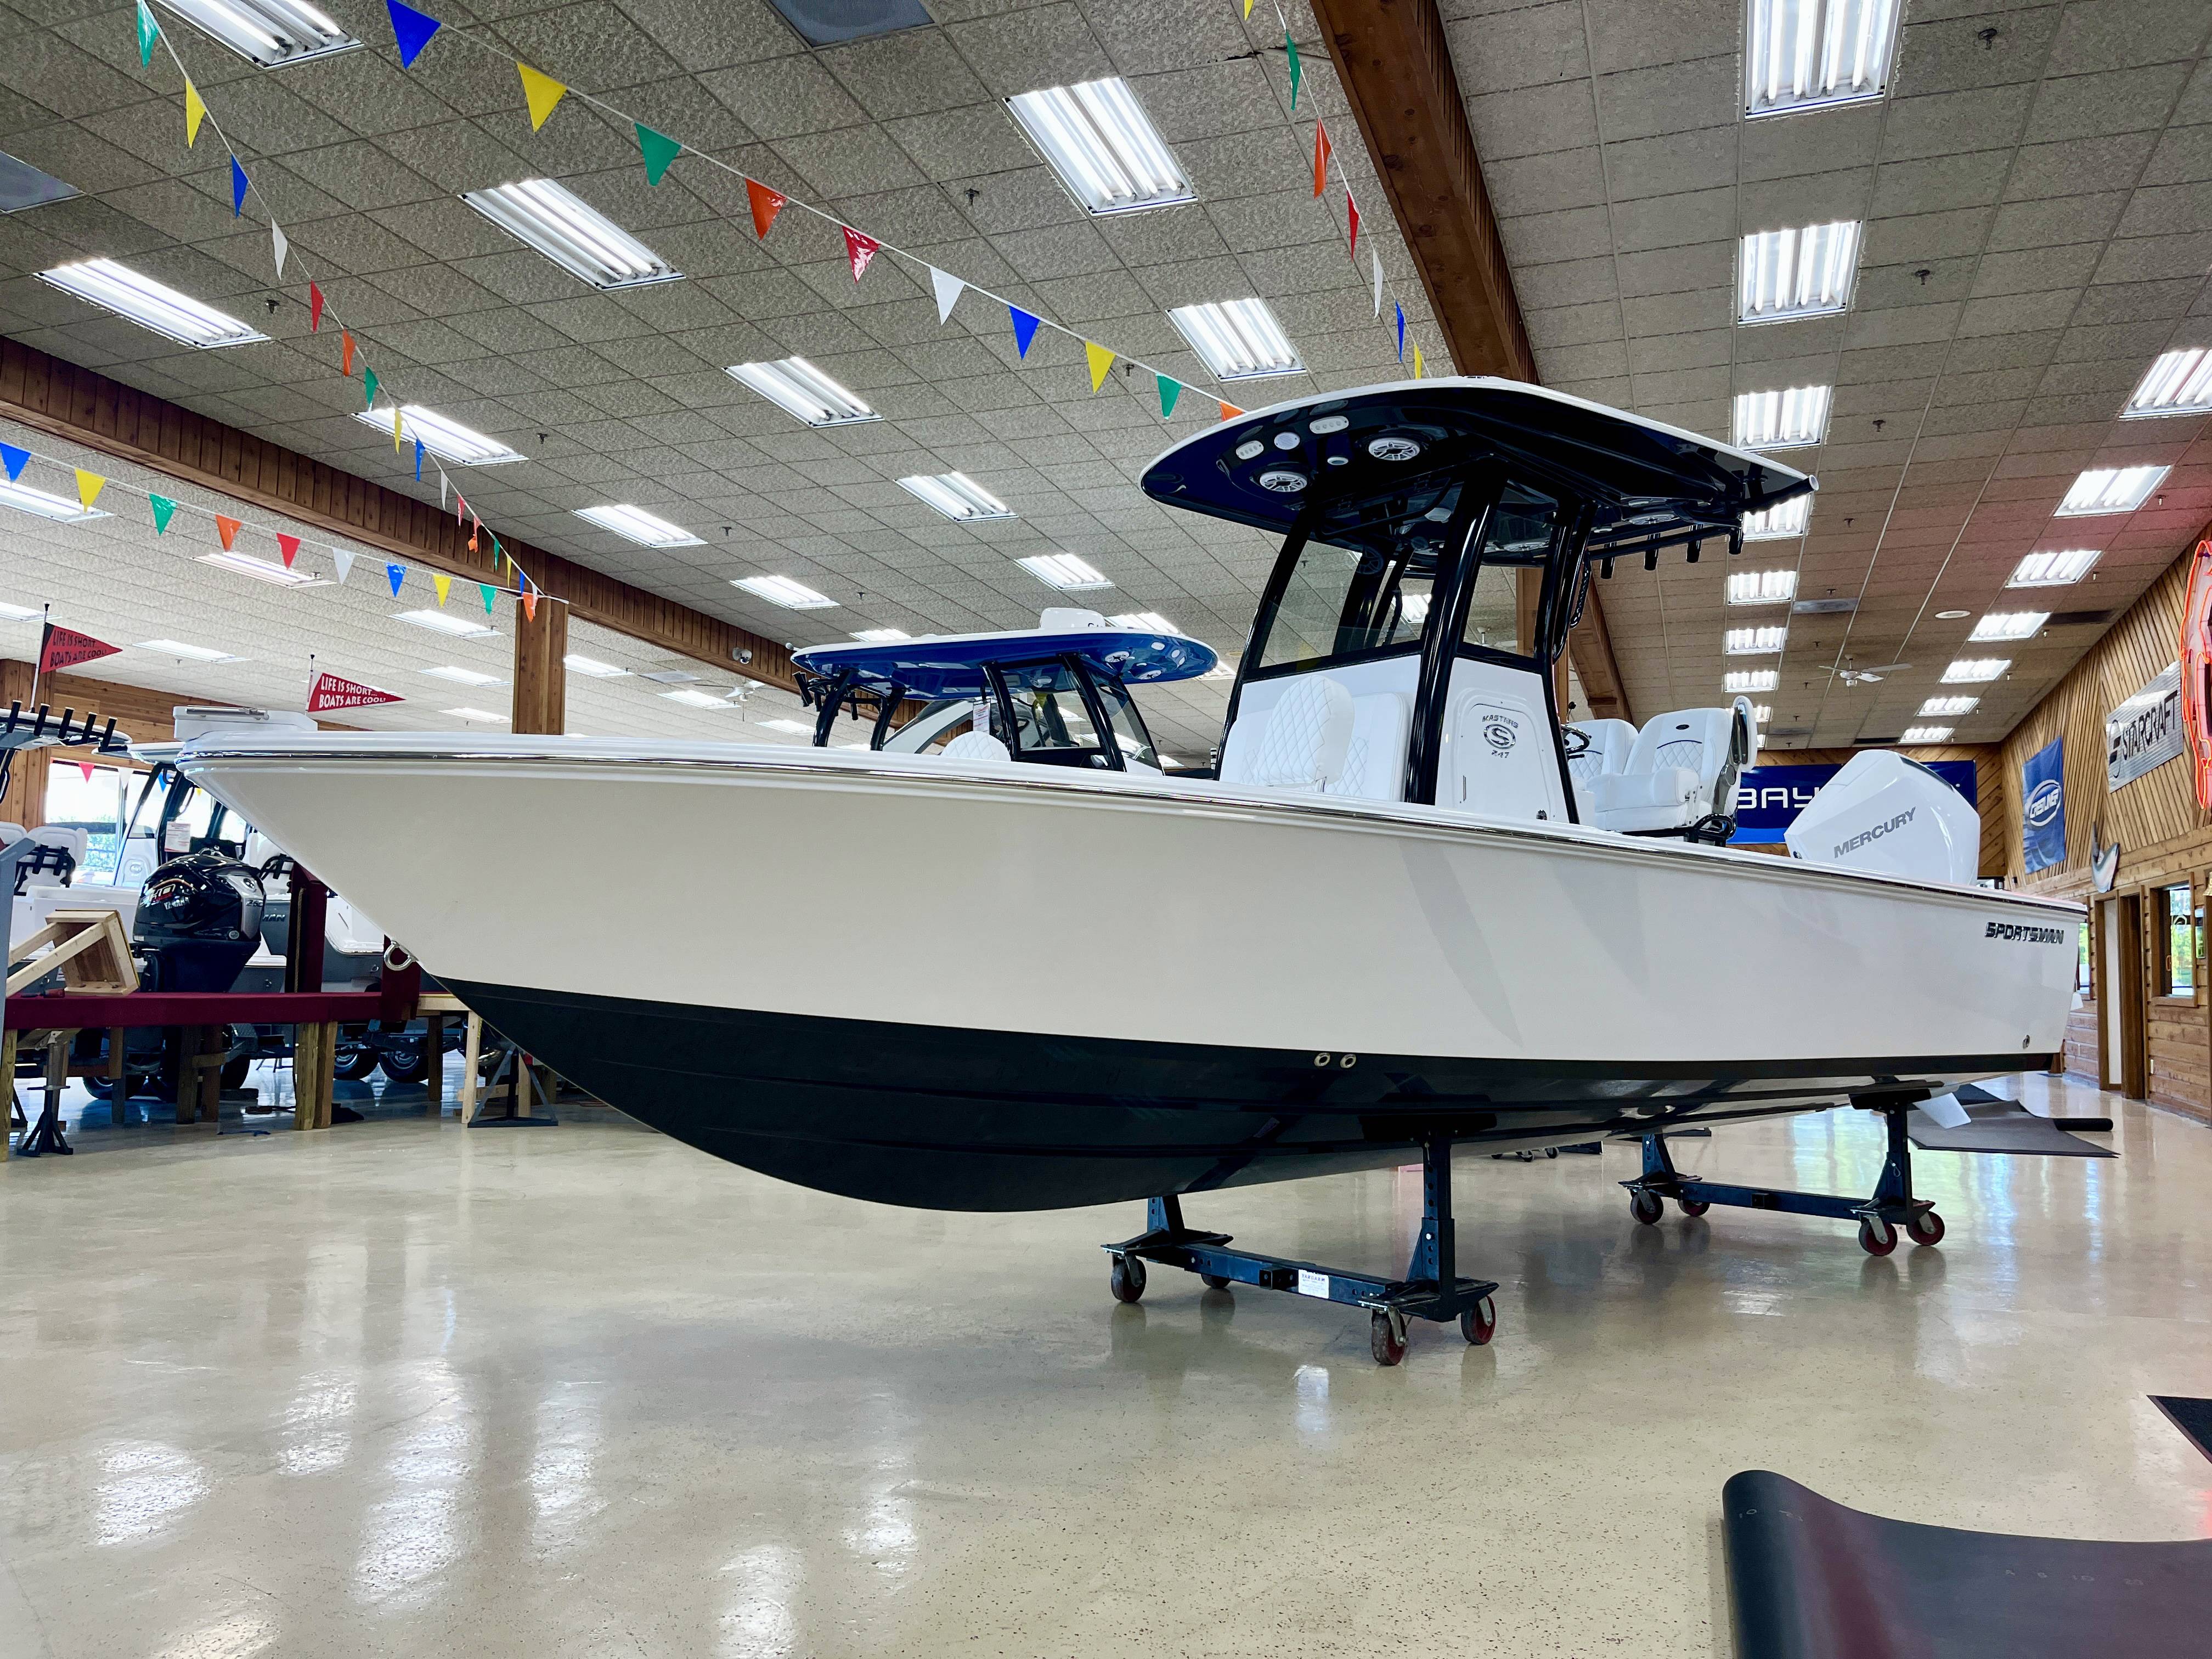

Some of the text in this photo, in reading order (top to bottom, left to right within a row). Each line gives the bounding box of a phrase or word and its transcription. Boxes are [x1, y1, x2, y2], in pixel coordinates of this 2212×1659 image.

[53, 631, 65, 646] LIFE
[67, 634, 73, 646] IS
[50, 651, 72, 667] BOATS
[72, 650, 86, 661] ARE
[320, 675, 337, 692] LIFE
[337, 680, 346, 692] IS
[319, 693, 386, 709] BOATS ARE COOL!
[1482, 714, 1519, 729] MASTERS
[2122, 690, 2178, 760] STARCRAFT
[1491, 749, 1510, 758] 247
[1833, 806, 1916, 859] MERCURY
[1985, 922, 2064, 945] SPORTSMAN
